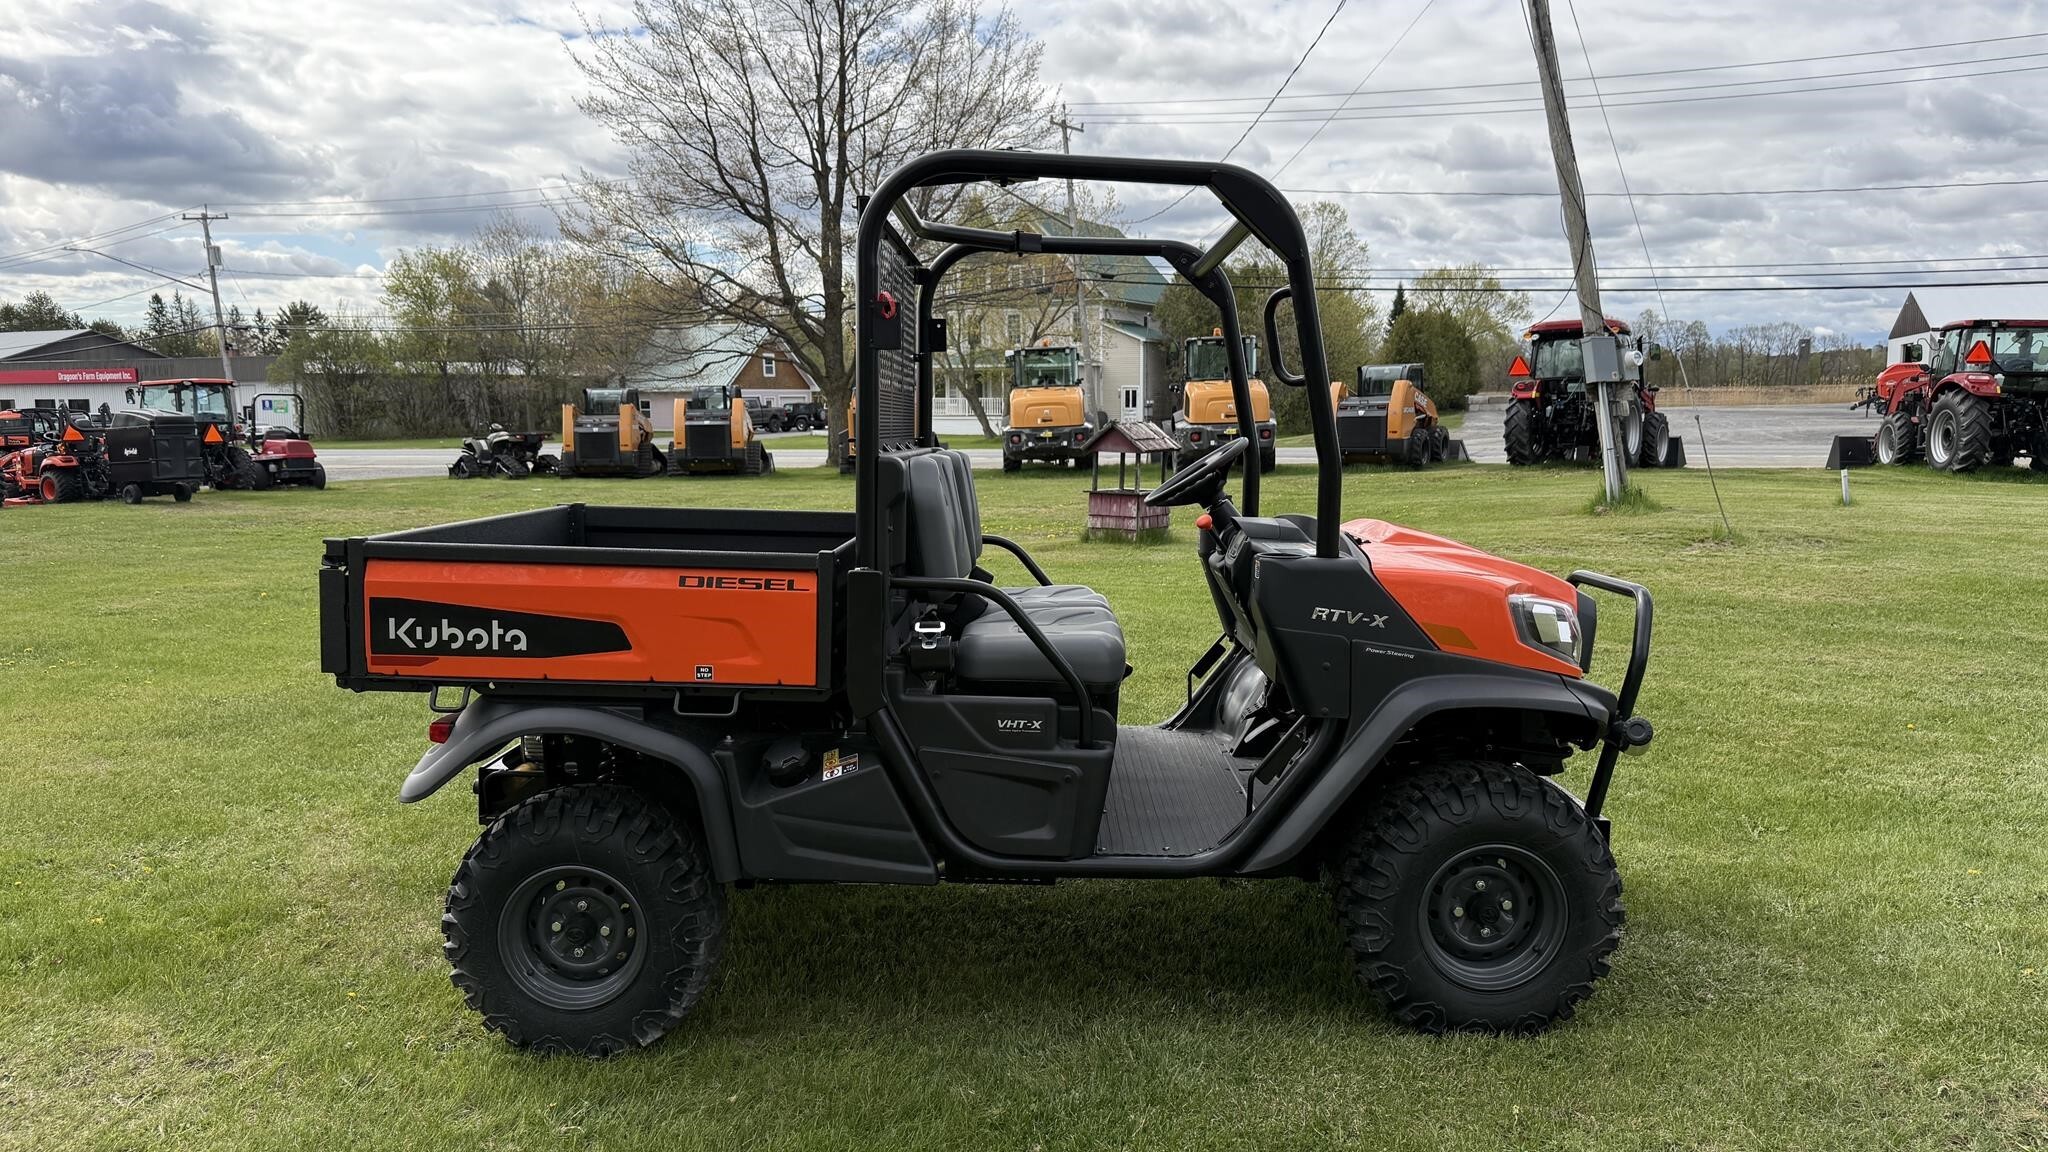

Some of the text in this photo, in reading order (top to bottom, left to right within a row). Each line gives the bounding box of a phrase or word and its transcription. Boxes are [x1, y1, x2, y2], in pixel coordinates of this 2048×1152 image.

[83, 371, 95, 380] Farm
[96, 371, 122, 382] Equipment
[122, 371, 132, 380] Inc.
[679, 575, 810, 591] DIESEL
[1311, 607, 1389, 628] RTV-X
[388, 617, 527, 651] Kubota
[1387, 650, 1415, 659] Steering
[997, 719, 1042, 729] VHT-X
